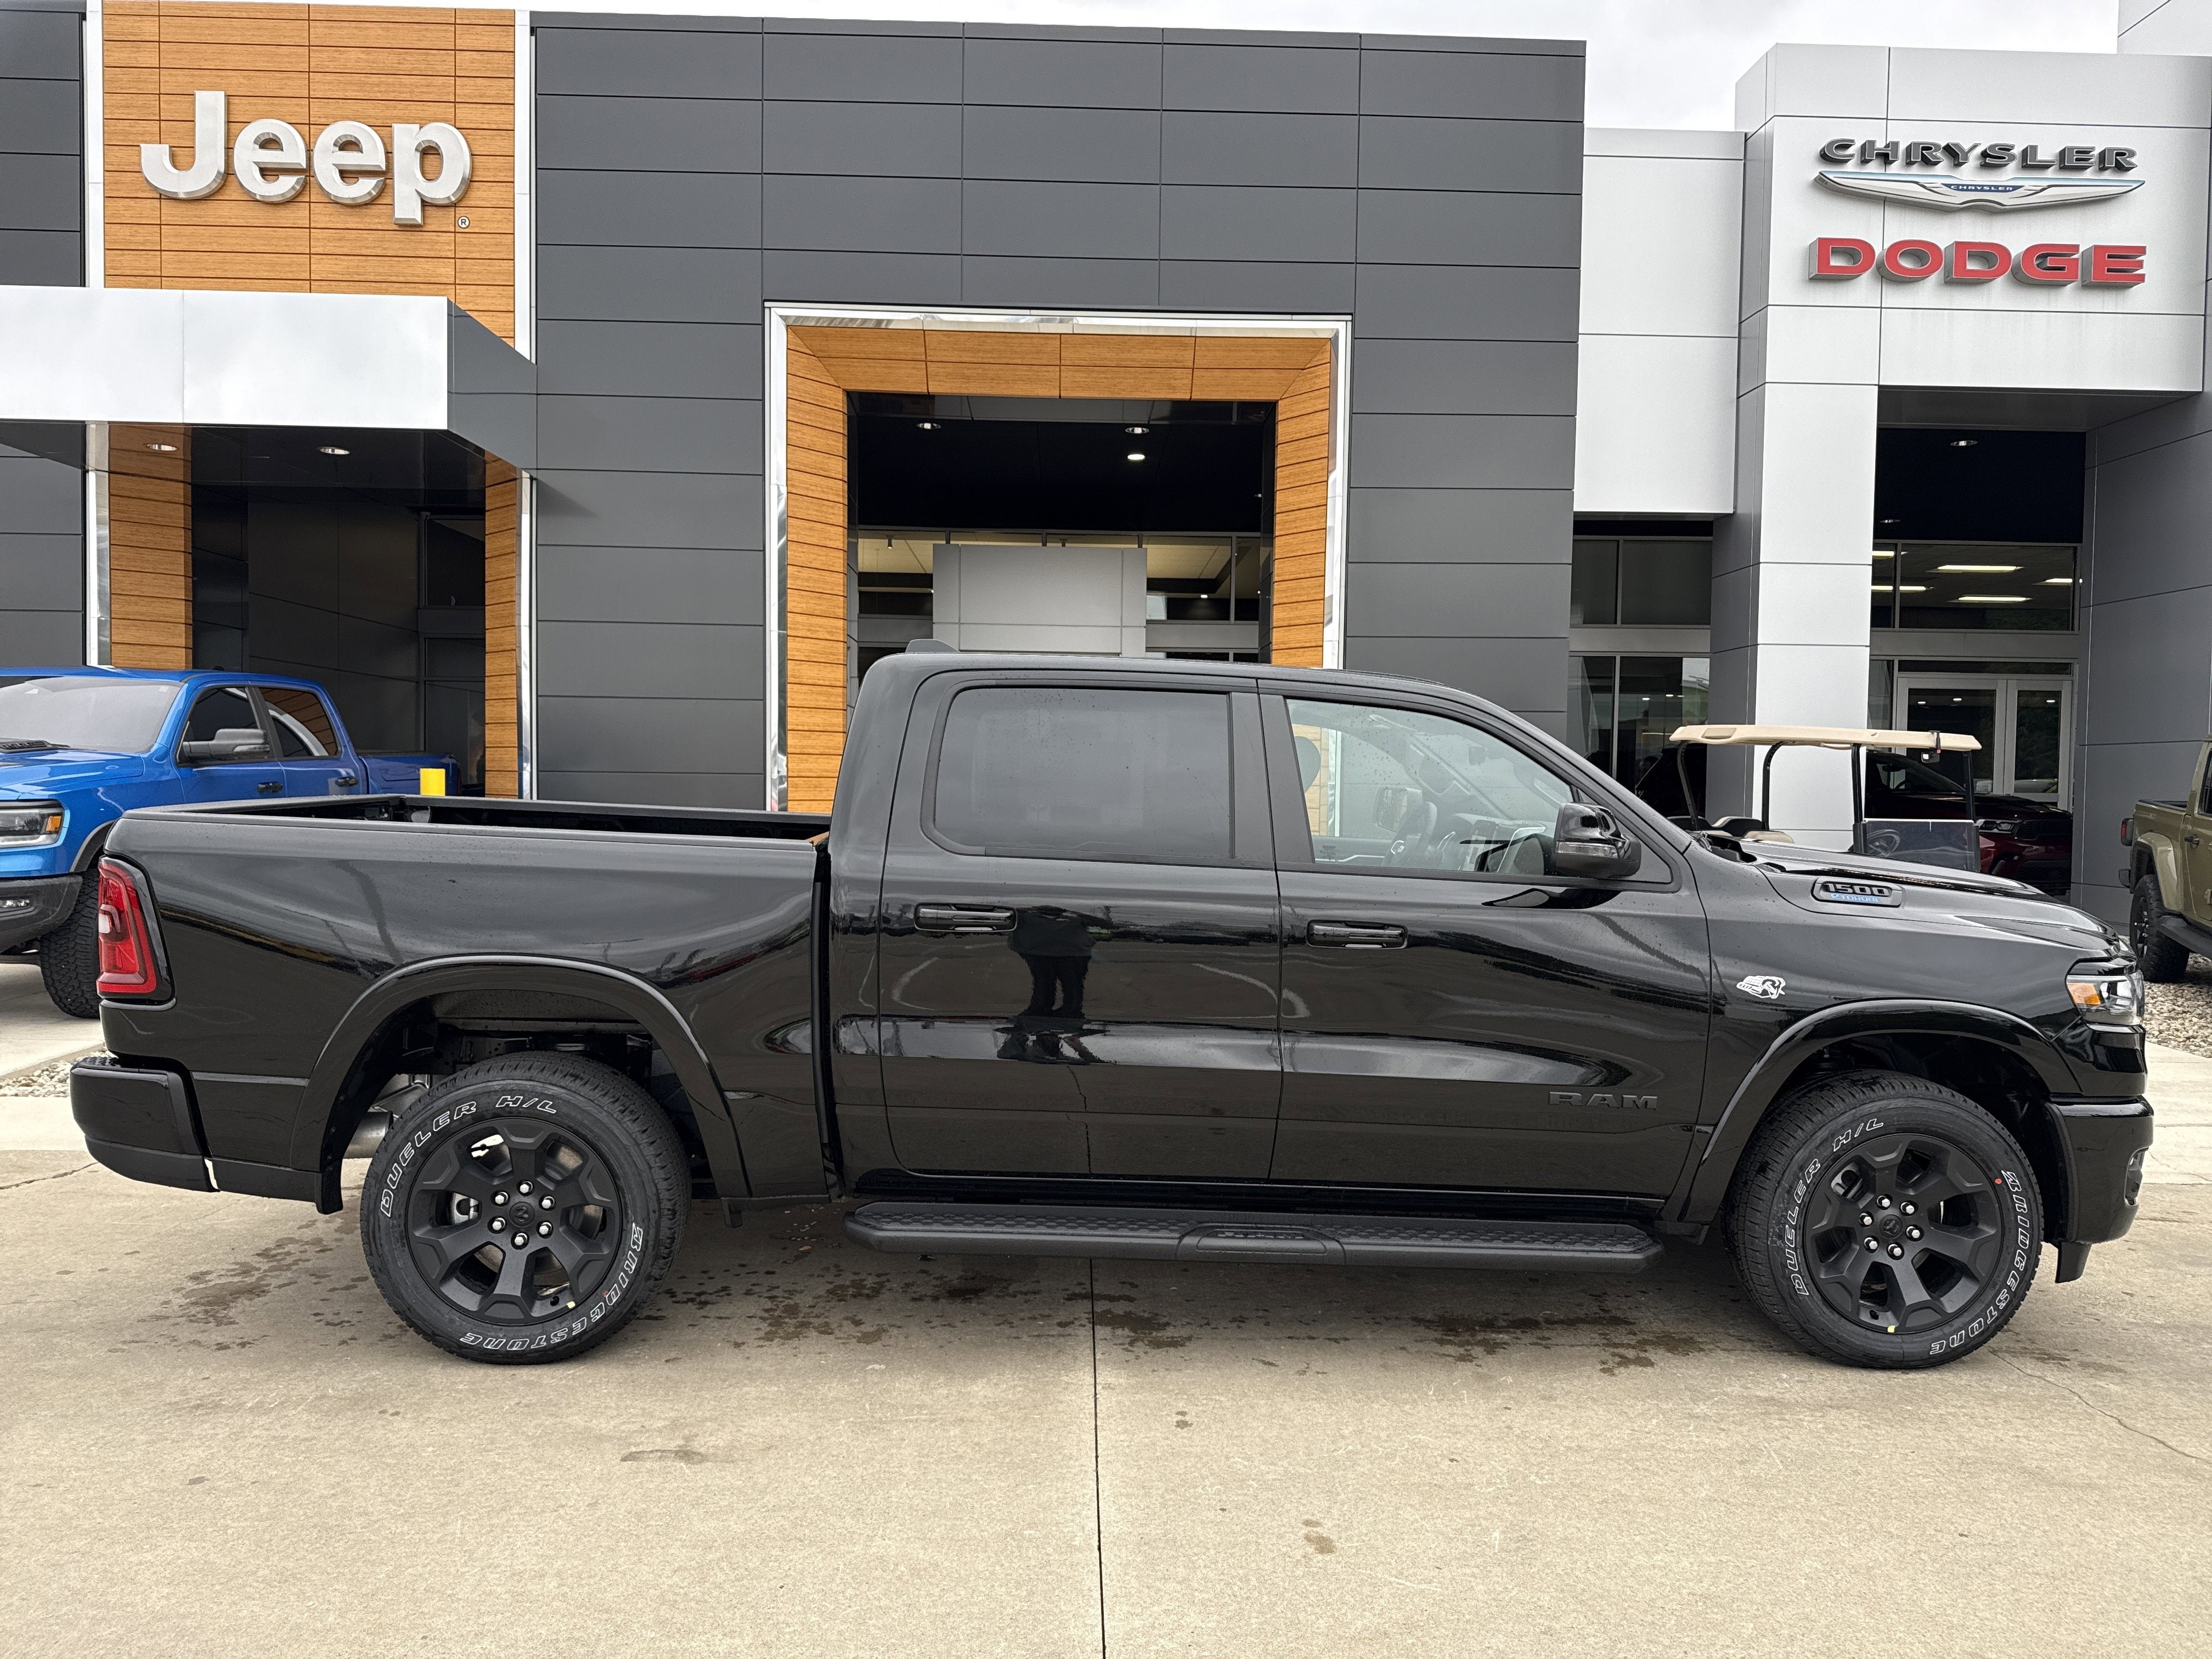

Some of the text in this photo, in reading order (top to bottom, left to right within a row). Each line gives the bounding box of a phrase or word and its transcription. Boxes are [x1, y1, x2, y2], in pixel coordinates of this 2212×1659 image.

[140, 91, 473, 227] Jeep
[1819, 138, 2138, 170] CHRYSLER
[1809, 238, 2147, 287] DODGE
[1824, 883, 1889, 896] 1500
[380, 1096, 557, 1217] DUELER H/L
[1548, 1091, 1657, 1109] RAM
[1786, 1118, 1884, 1295] DUELER H/L
[1929, 1170, 2030, 1355] BRIDGESTONE
[460, 1223, 644, 1350] BRIDGESTONE
